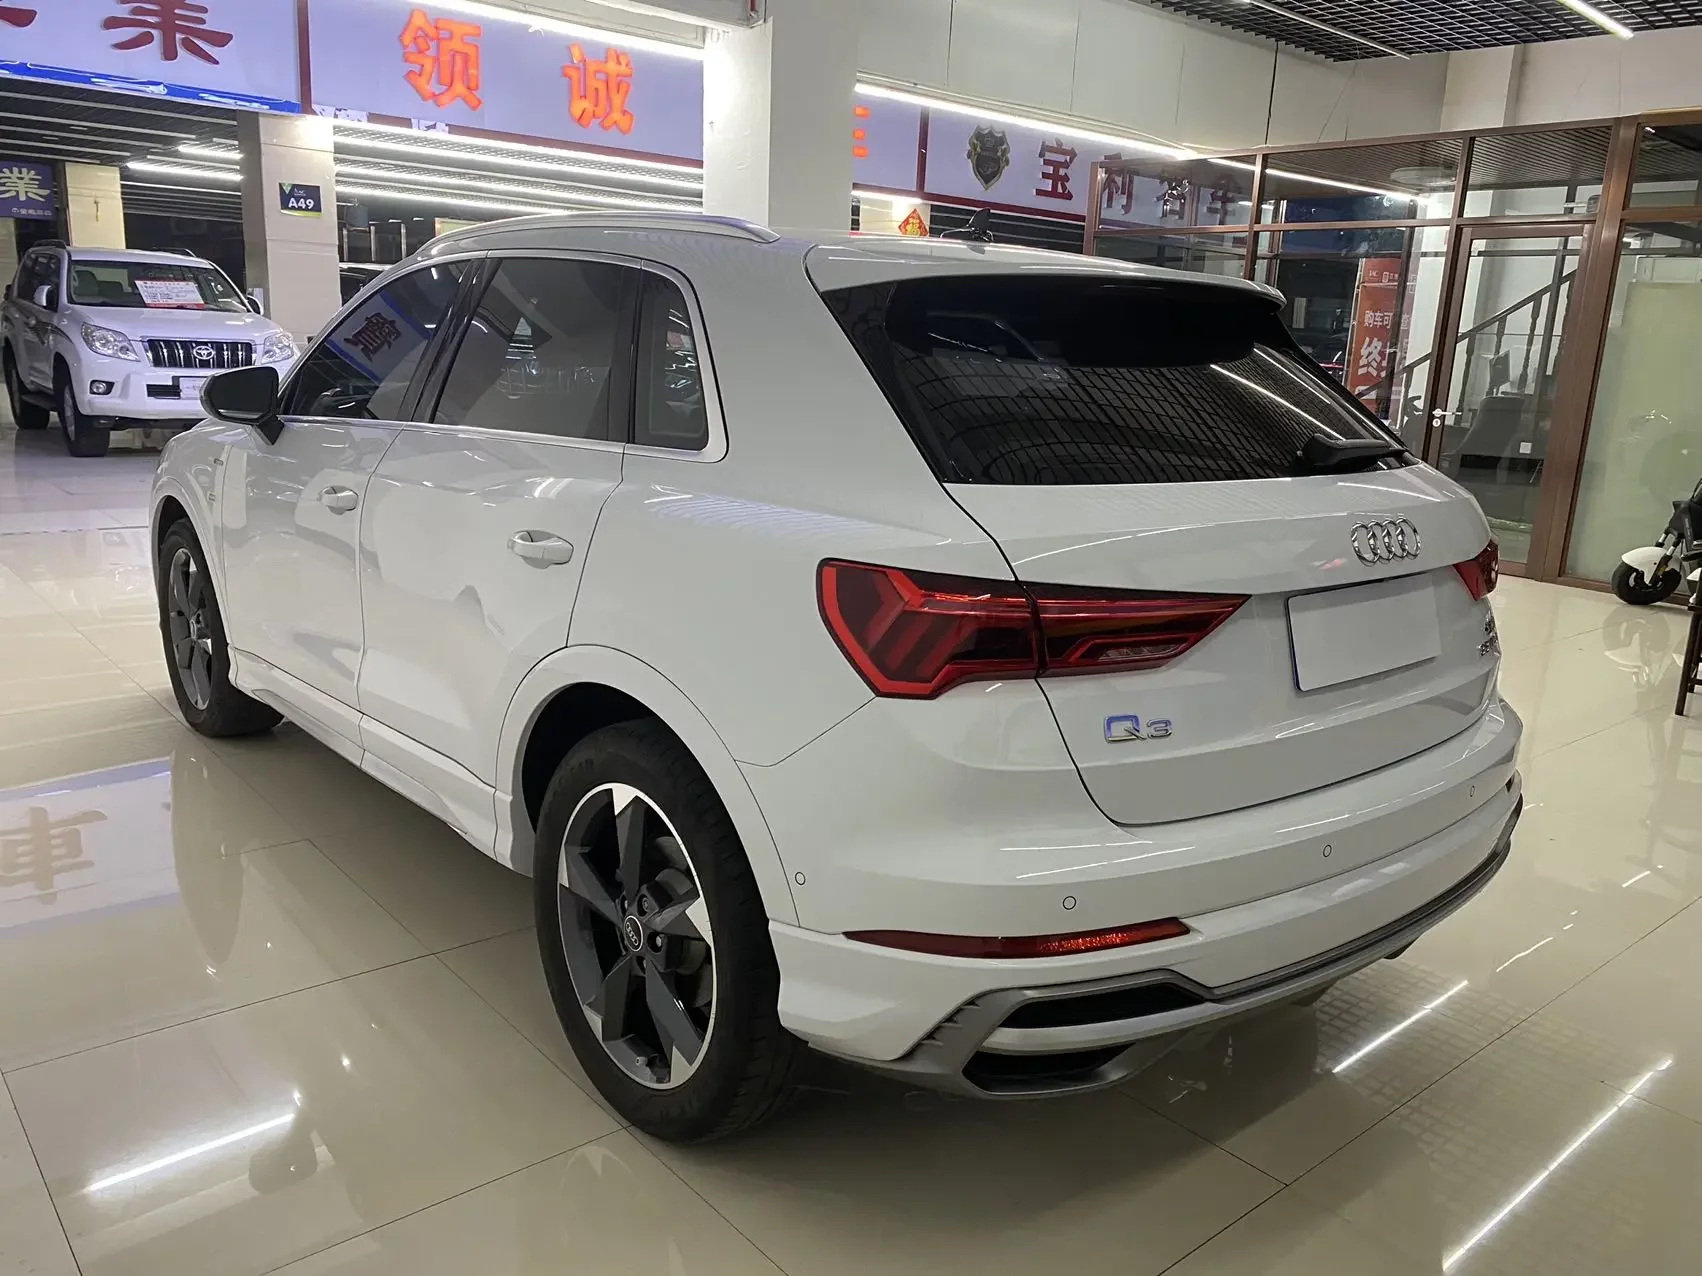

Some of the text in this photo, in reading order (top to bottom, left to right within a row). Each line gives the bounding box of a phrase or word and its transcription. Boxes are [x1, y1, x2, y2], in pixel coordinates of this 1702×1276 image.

[288, 197, 315, 210] A49
[1357, 337, 1387, 377] 终
[1104, 714, 1173, 743] Q3
